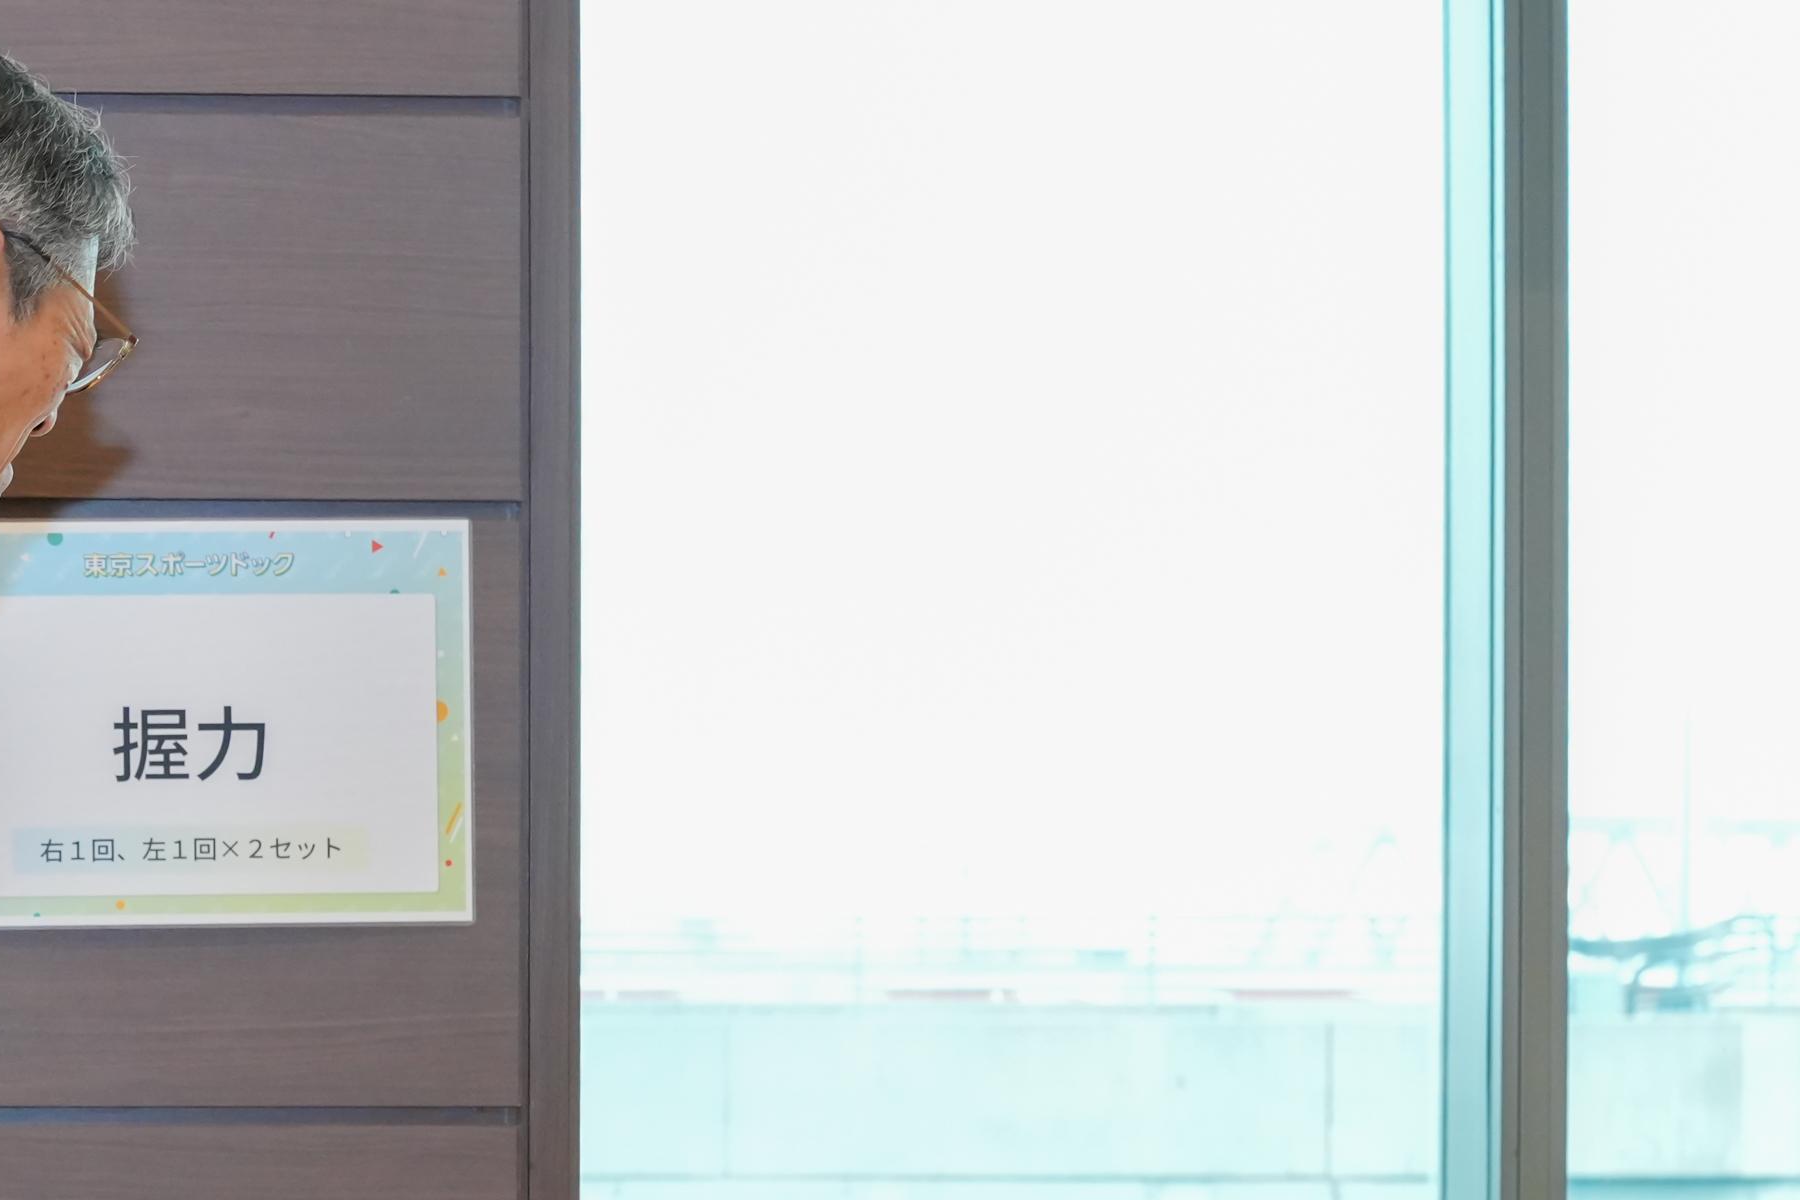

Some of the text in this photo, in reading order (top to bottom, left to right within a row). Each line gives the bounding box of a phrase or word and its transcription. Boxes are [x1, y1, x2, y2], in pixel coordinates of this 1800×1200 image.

[83, 551, 296, 578] 東京スポーツドック
[112, 705, 266, 783] 握力
